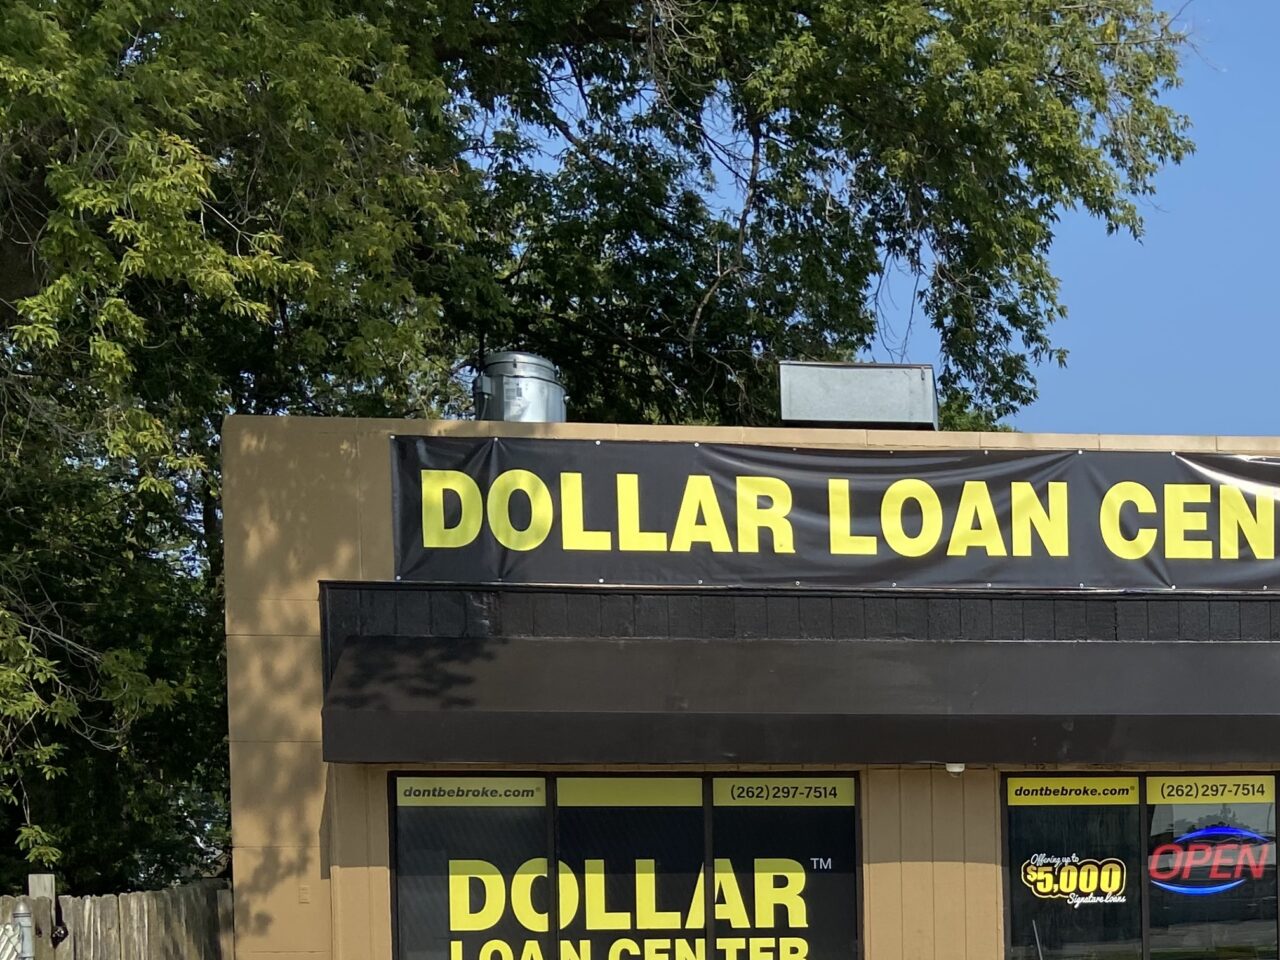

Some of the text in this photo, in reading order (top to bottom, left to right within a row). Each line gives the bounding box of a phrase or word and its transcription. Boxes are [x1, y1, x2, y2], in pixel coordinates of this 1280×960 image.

[421, 468, 795, 555] DOLLAR
[827, 478, 1069, 558] LOAN
[1026, 863, 1121, 893] $5,000
[1030, 853, 1062, 869] Offering
[1149, 843, 1269, 880] OPEN
[448, 857, 809, 932] DOLLAR
